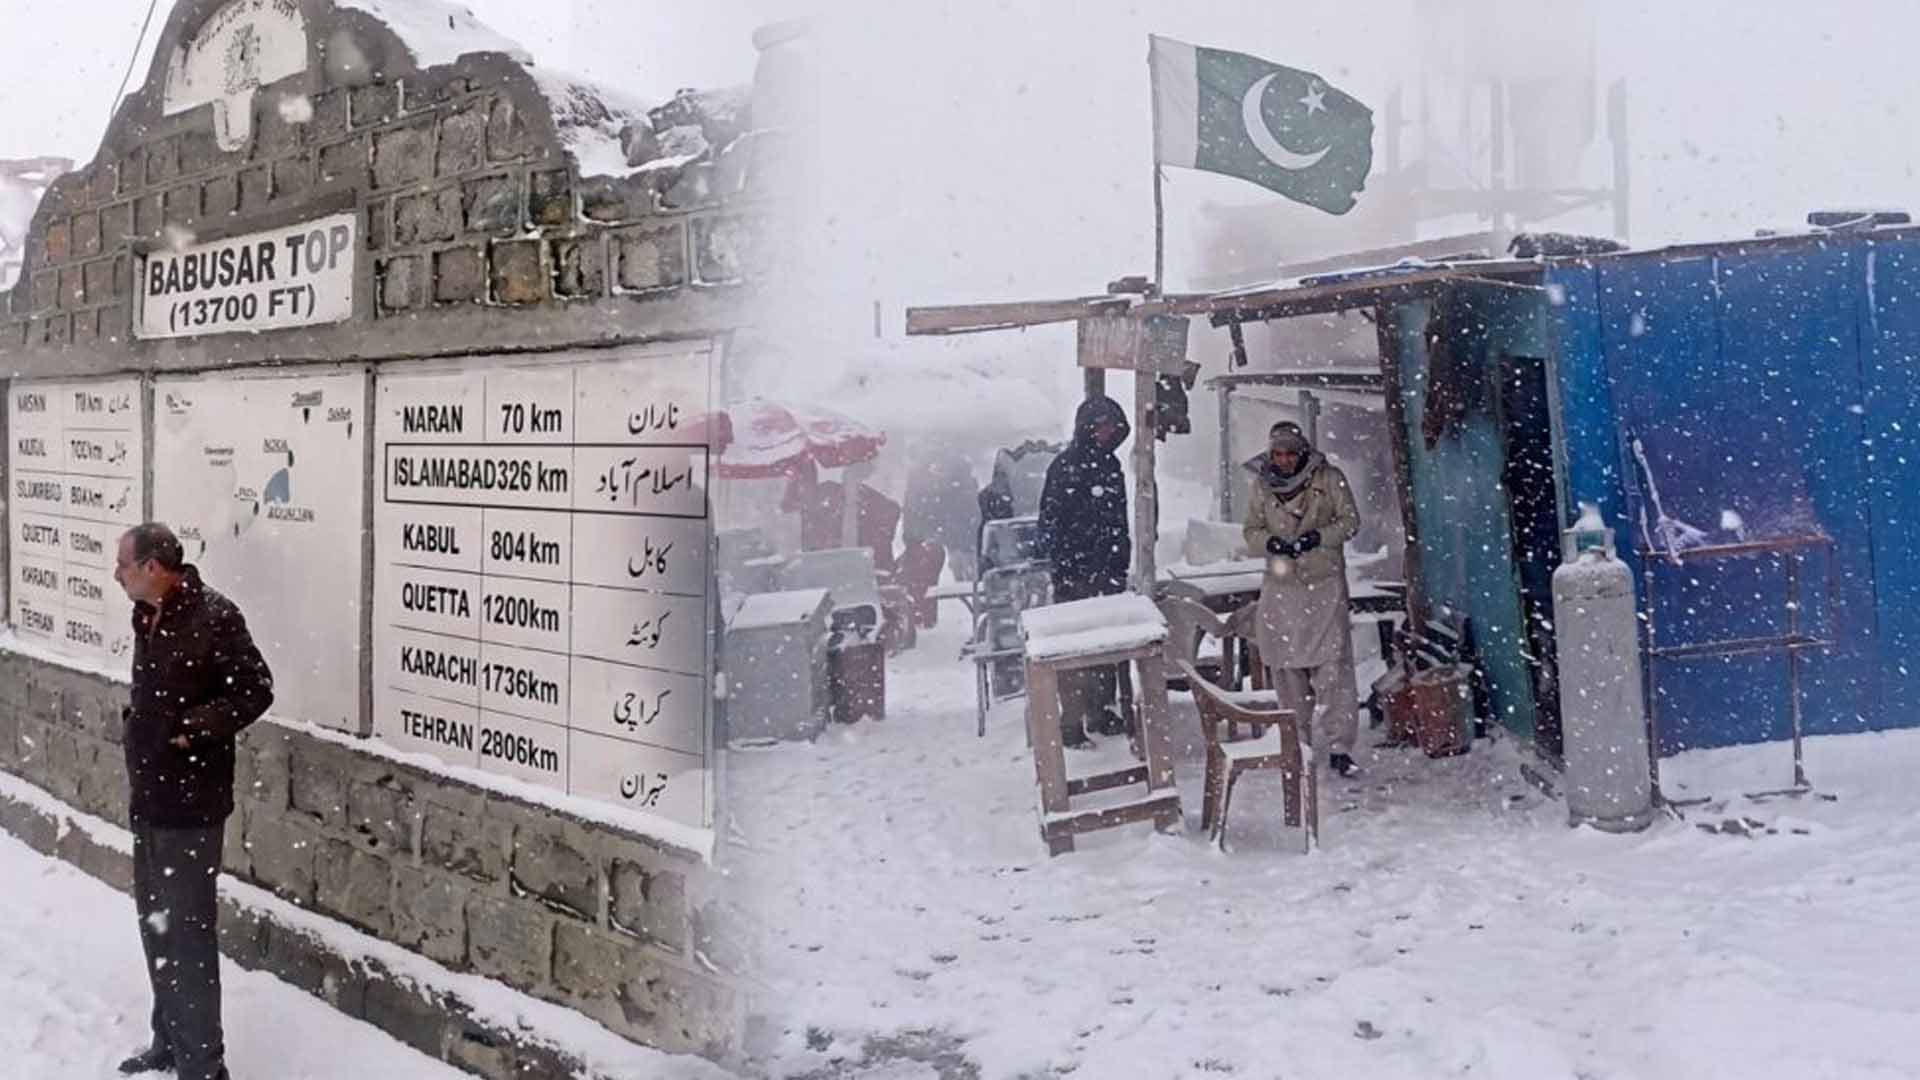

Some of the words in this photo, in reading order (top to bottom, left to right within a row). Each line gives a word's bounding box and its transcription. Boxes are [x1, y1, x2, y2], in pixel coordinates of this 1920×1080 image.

[149, 240, 276, 296] BABUSAR
[286, 224, 350, 278] TOP
[170, 292, 258, 333] (13700
[268, 283, 316, 319] FT)
[402, 404, 464, 434] NARAN
[501, 403, 525, 434] 70
[531, 403, 563, 433] km
[628, 402, 680, 435] ناران
[538, 461, 568, 493] km
[402, 523, 460, 554] KABUL
[628, 536, 674, 577] کابل
[402, 582, 470, 618] QUETTA
[483, 594, 560, 632] 1200km
[401, 646, 477, 687] KARACHI
[482, 663, 559, 705] 1736km
[401, 710, 474, 751] TEHRAN
[613, 689, 672, 731] کراچی
[481, 728, 559, 772] 2806km
